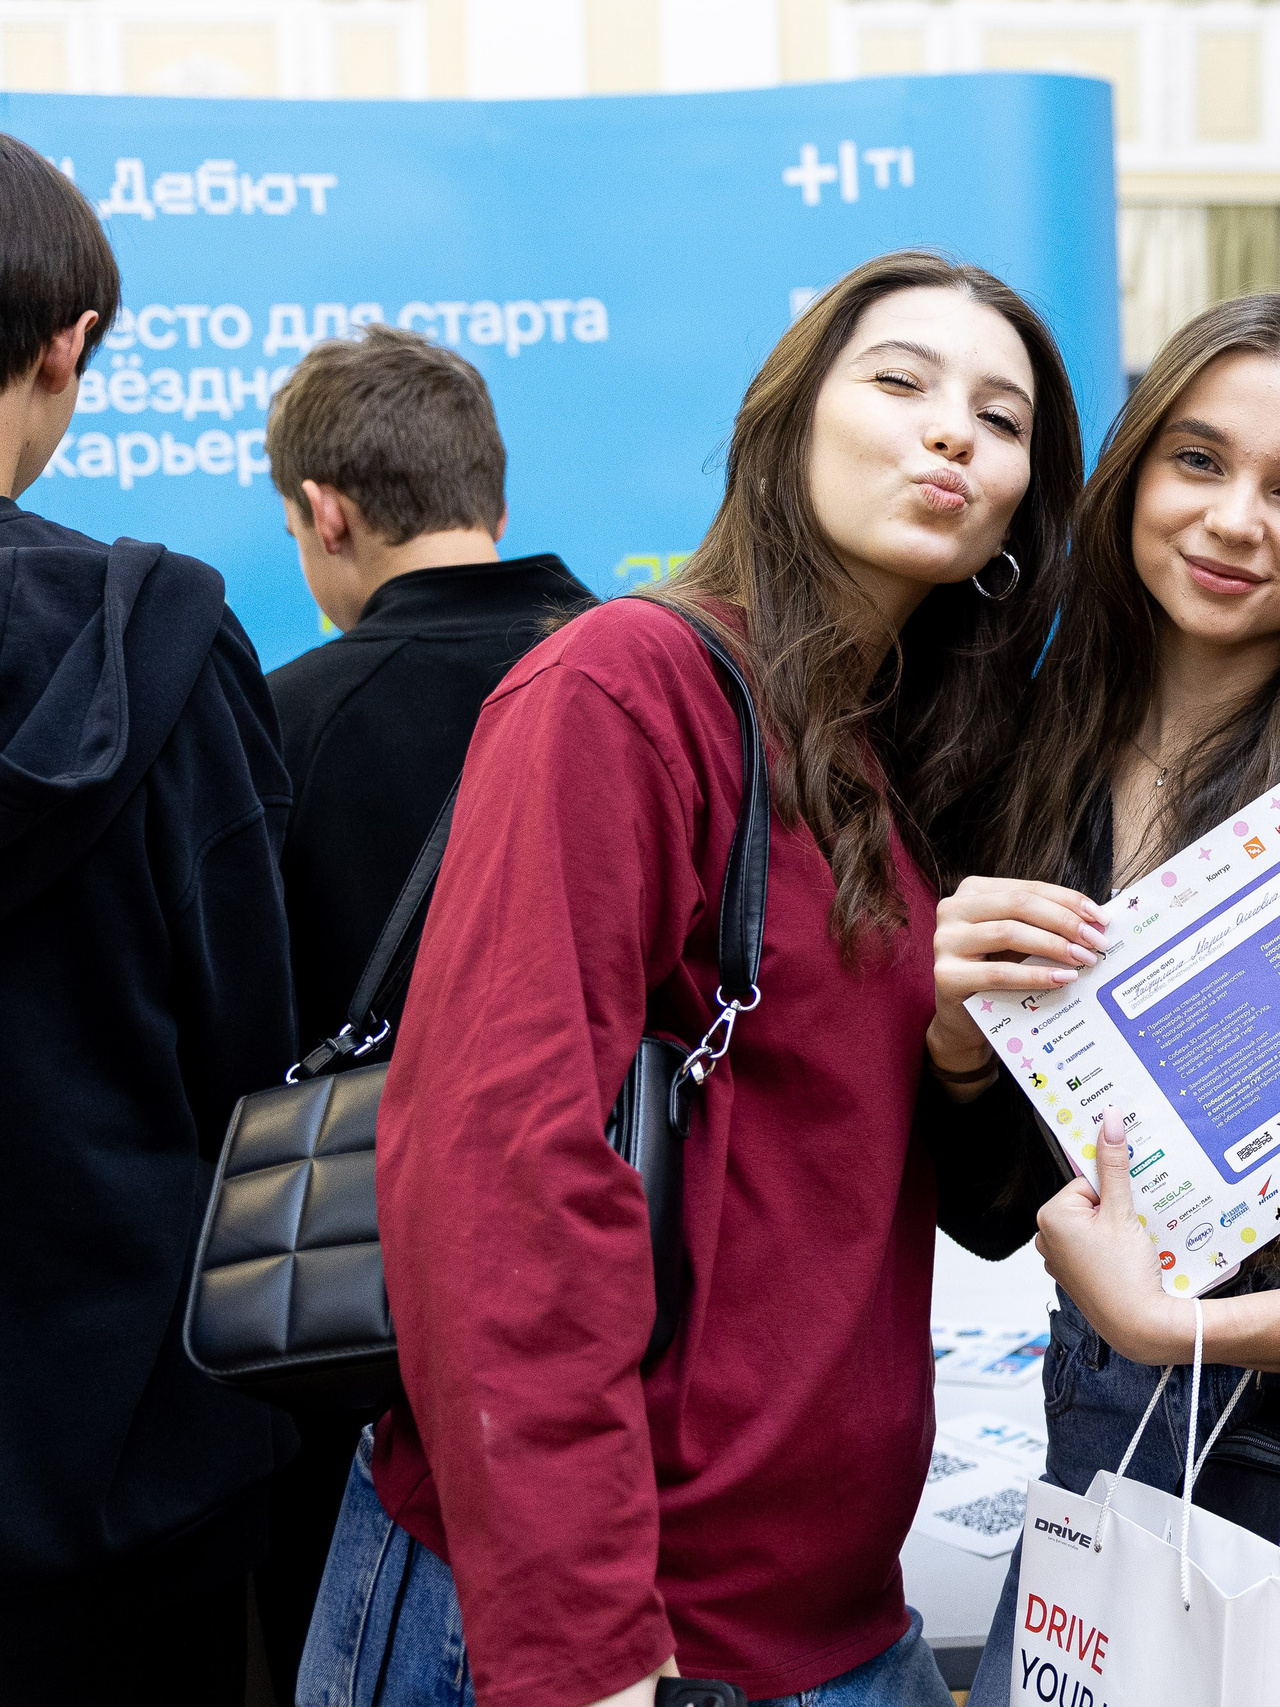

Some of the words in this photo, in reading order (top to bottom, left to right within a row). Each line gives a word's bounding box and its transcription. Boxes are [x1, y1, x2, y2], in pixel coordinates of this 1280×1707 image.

[100, 157, 338, 221] Дебют
[397, 297, 609, 358] старта
[1206, 862, 1230, 882] Контур
[1141, 912, 1160, 928] СБЕР
[1122, 978, 1146, 997] Напиши
[1146, 968, 1160, 980] свое
[1159, 957, 1175, 970] ФИО
[1038, 997, 1081, 1031] СОВКОМБАНК
[1051, 1033, 1064, 1044] SLK
[1063, 1019, 1085, 1036] Cement
[1065, 1040, 1095, 1064] ГАЗПРОМБАНК
[1080, 1081, 1113, 1107] Сколтех
[1139, 1169, 1169, 1193] maxim
[1152, 1179, 1193, 1211] REGLAB
[1178, 1194, 1212, 1220] СИГНАЛ-ПАК
[1160, 1253, 1173, 1266] hh
[1034, 1517, 1093, 1549] DRIVE
[1024, 1593, 1109, 1676] DRIVE
